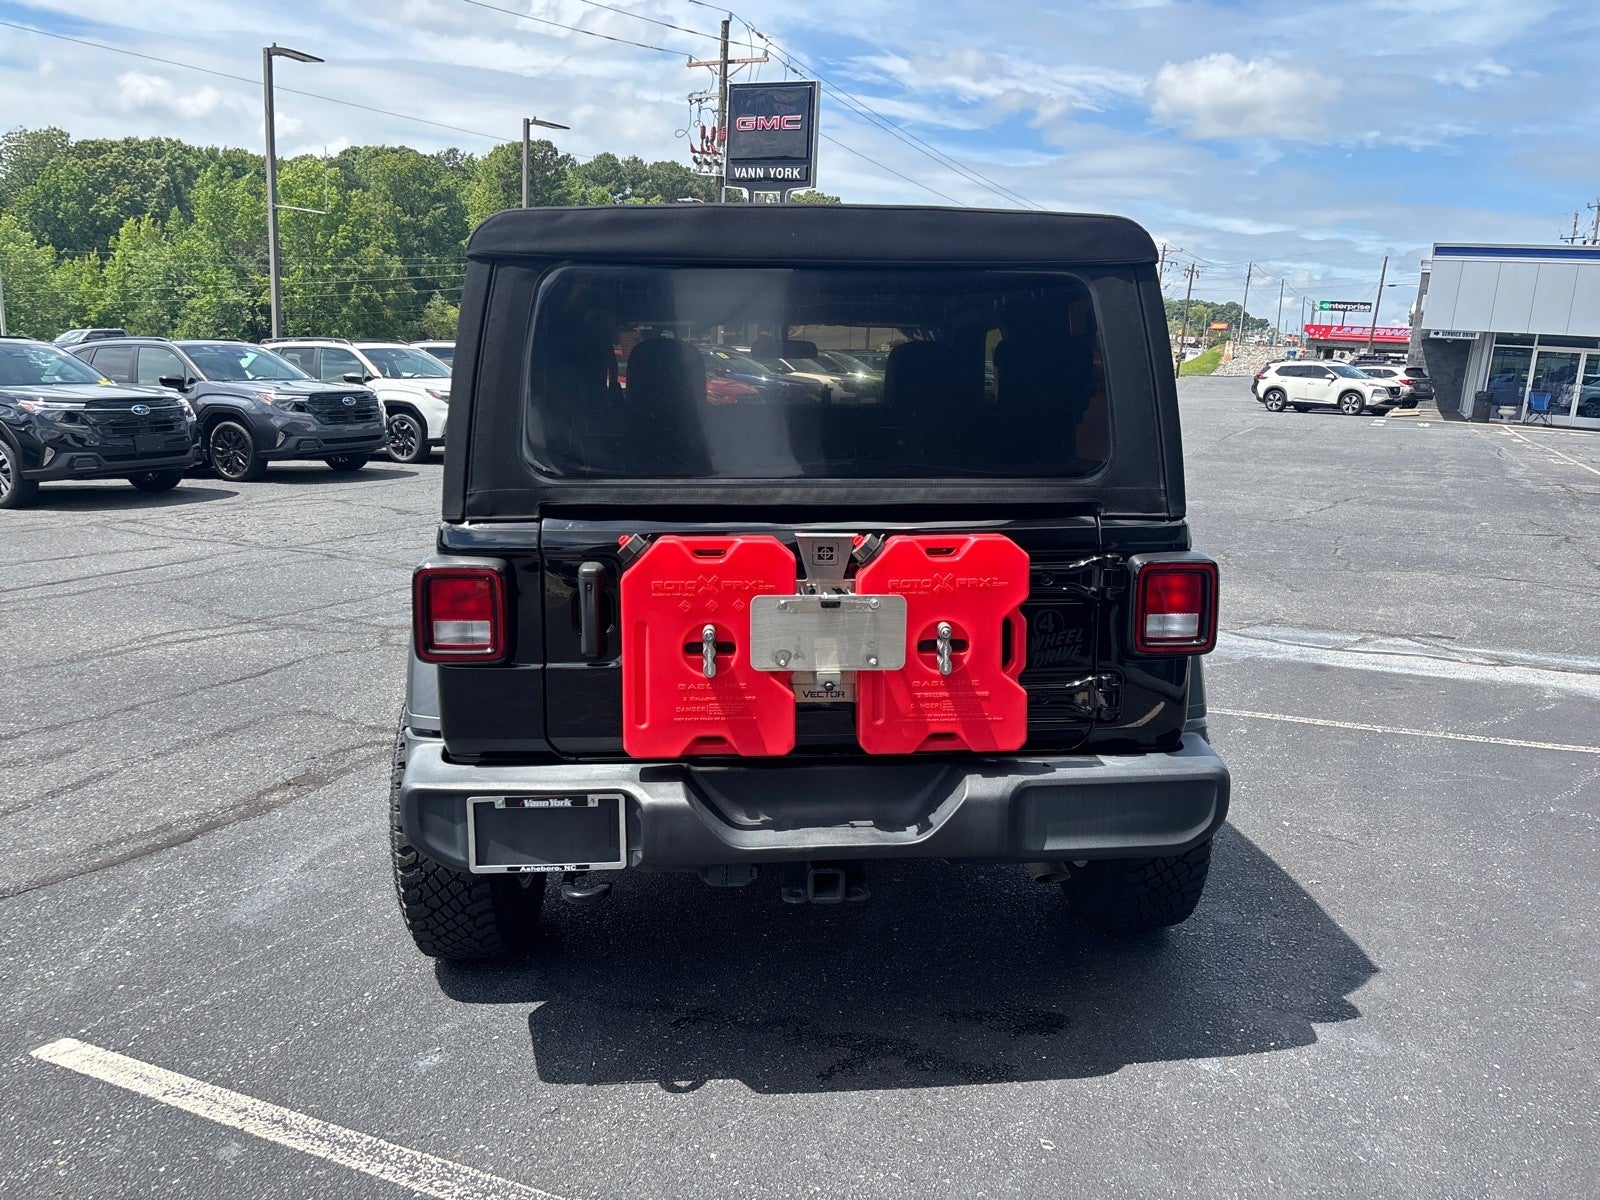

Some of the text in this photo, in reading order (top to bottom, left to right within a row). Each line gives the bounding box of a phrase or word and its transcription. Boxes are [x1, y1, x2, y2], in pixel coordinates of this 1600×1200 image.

[736, 115, 801, 131] GMC
[735, 167, 800, 178] VANN YORK
[1038, 612, 1054, 632] 4
[1032, 628, 1084, 650] WHEEL
[1033, 645, 1083, 668] DRIVE
[802, 690, 845, 698] VECTOR
[524, 798, 573, 808] Vann York
